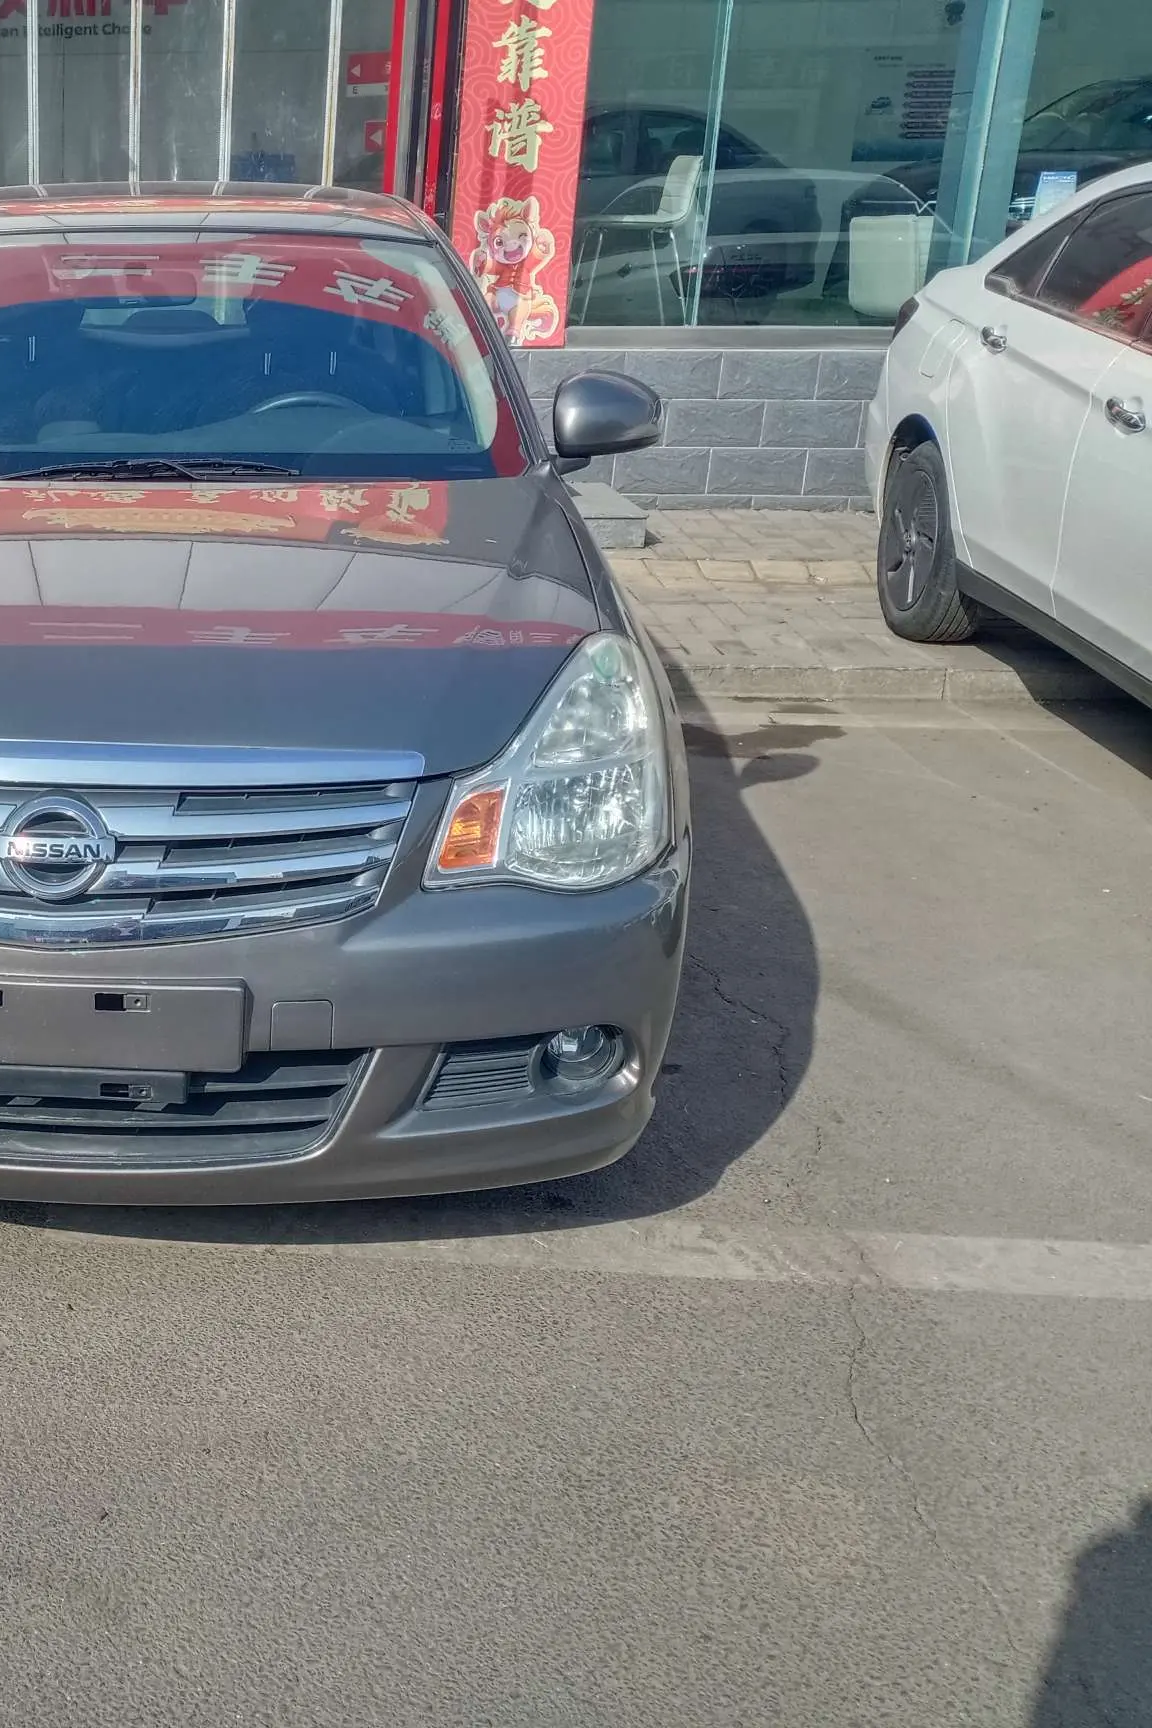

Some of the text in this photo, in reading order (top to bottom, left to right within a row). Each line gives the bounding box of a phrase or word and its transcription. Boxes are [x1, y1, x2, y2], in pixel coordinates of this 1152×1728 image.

[22, 24, 98, 39] Itelligent
[102, 22, 152, 36] Choe
[484, 0, 557, 173] 靠谱
[7, 841, 101, 859] NISSAN
